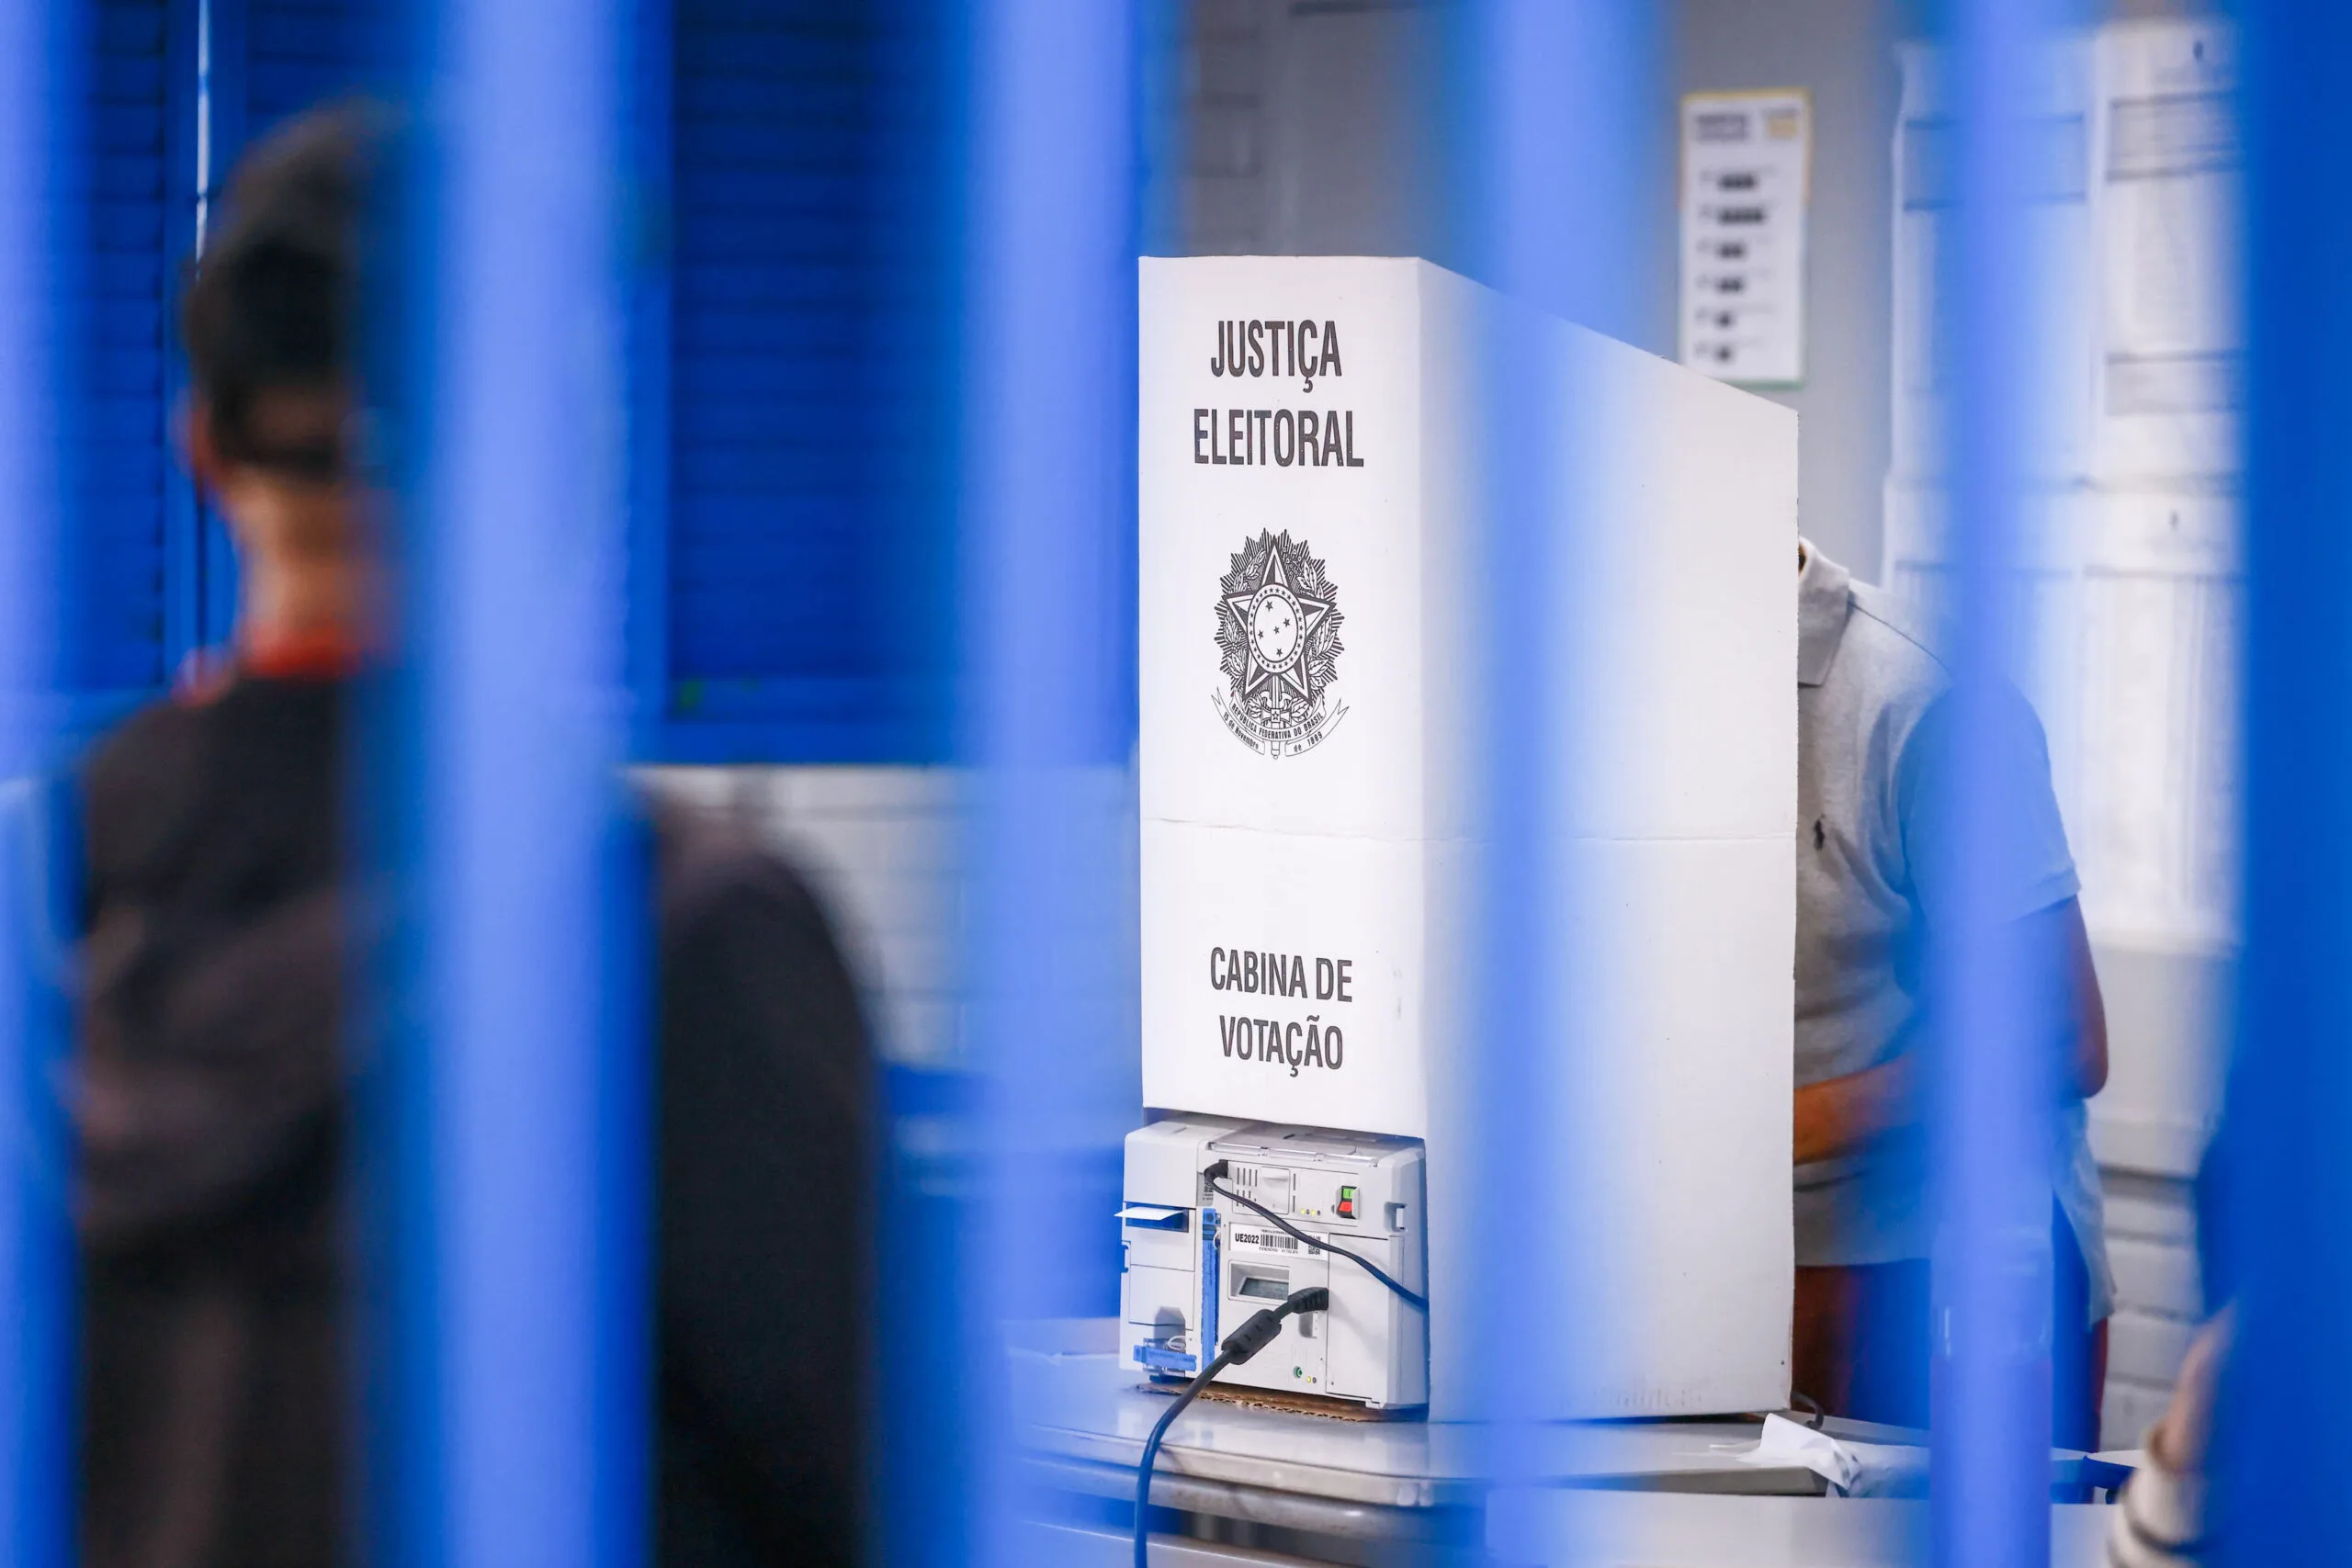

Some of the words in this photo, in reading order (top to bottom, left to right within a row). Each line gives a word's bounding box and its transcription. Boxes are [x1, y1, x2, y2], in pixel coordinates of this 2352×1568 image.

[1210, 319, 1342, 393] JUSTIÇA
[1194, 408, 1364, 468] ELEITORAL
[1259, 727, 1292, 740] FEDERATIVA
[1293, 727, 1302, 737] DO
[1303, 712, 1323, 732] BRASIL
[1294, 744, 1302, 752] de
[1210, 946, 1308, 998] CABINA
[1316, 957, 1352, 1002] DE
[1219, 1014, 1343, 1077] VOTAÇÃO
[1235, 1233, 1260, 1245] UE2022
